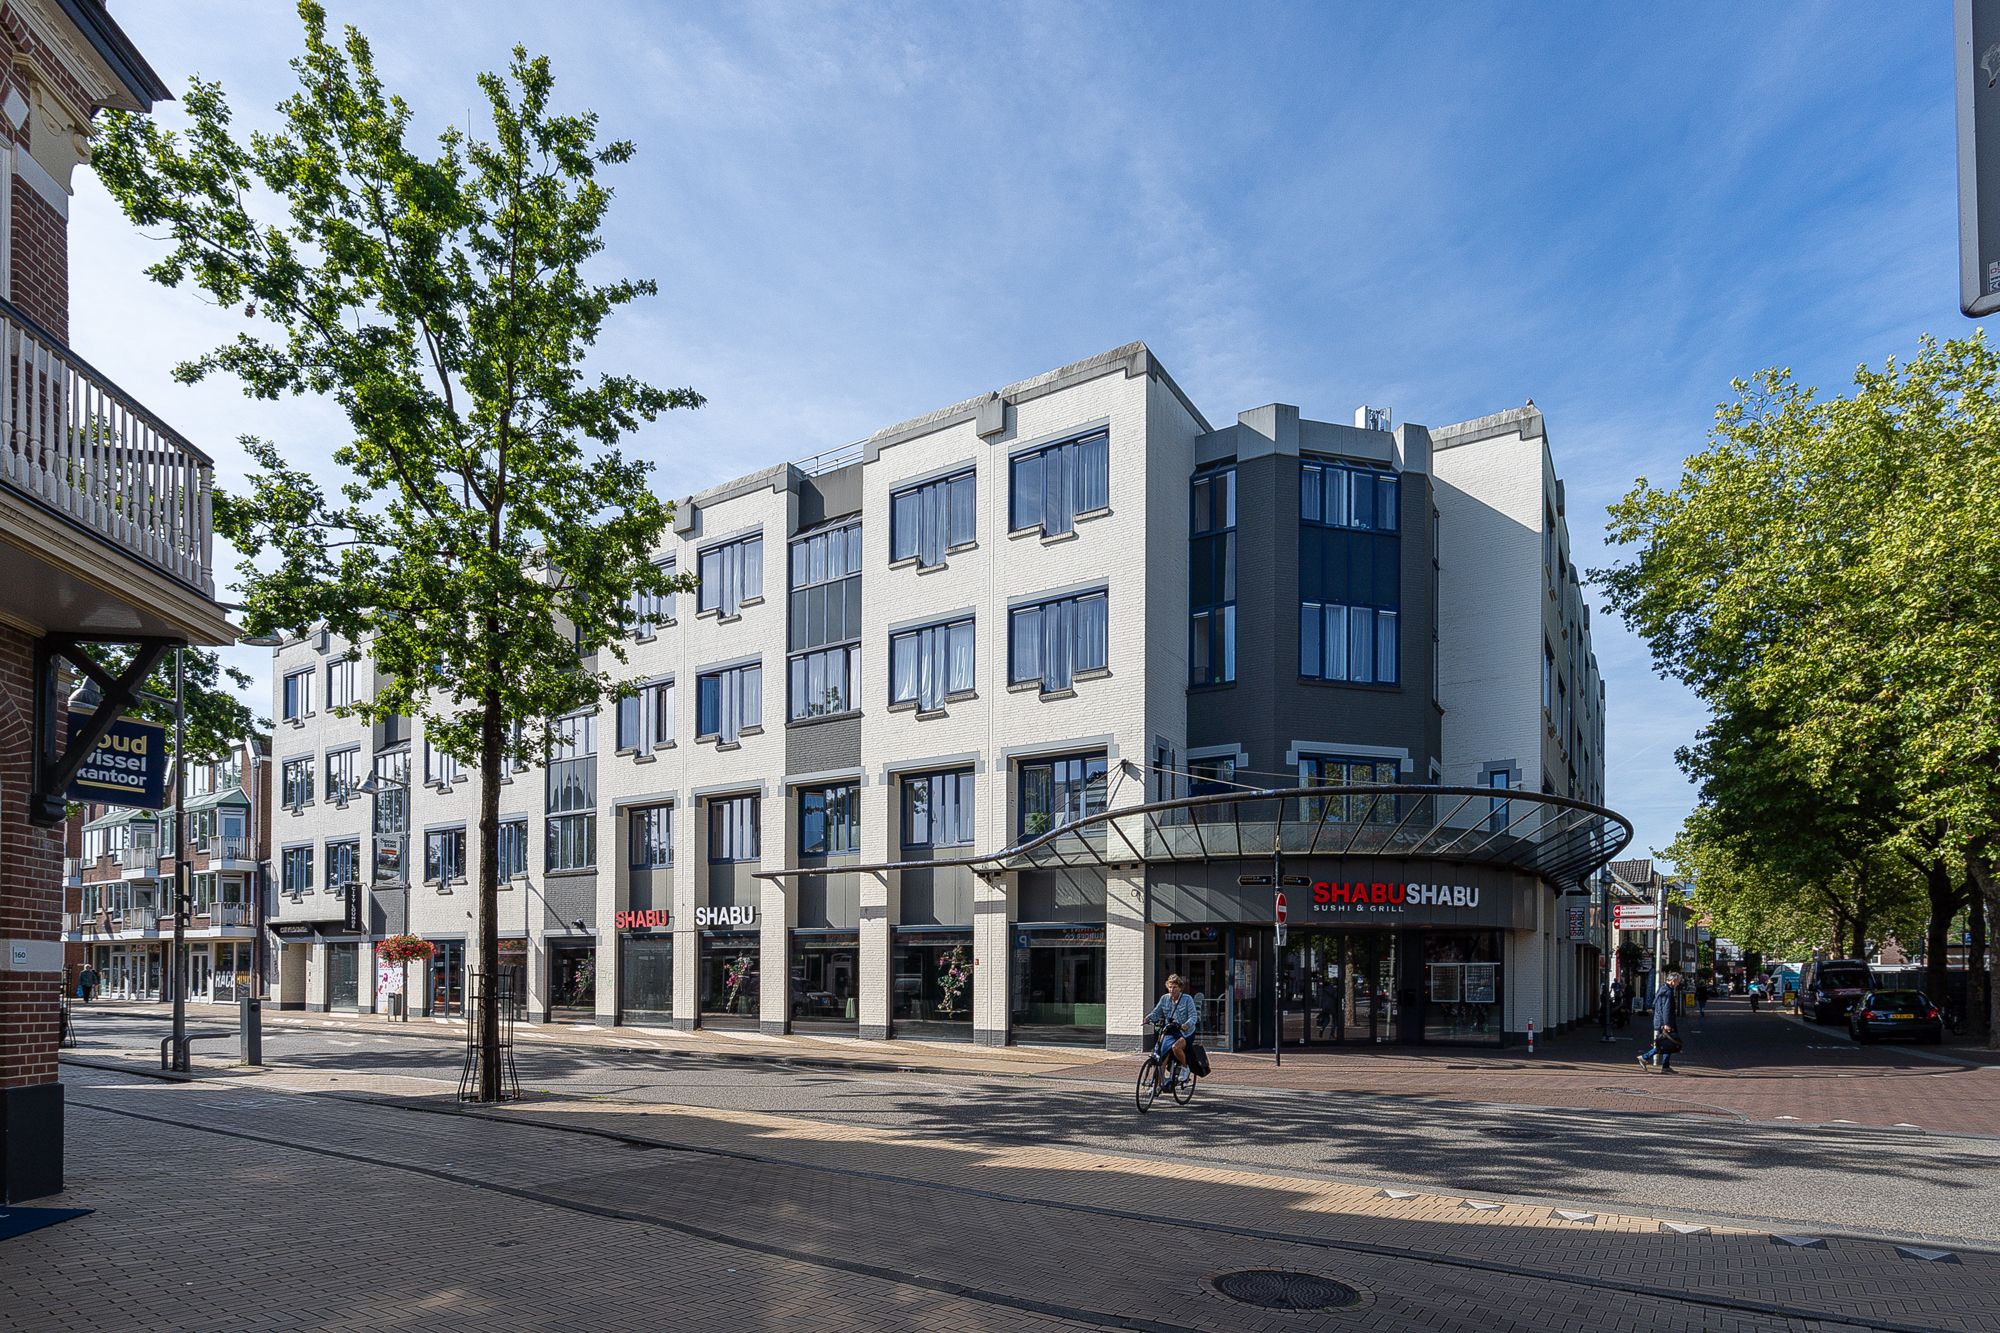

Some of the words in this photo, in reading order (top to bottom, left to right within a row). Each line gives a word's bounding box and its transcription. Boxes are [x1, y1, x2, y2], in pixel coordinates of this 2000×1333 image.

[1313, 904, 1350, 912] SUSHI
[1356, 904, 1364, 912] &
[615, 909, 668, 928] SHABU
[695, 905, 755, 925] SHABU
[15, 951, 26, 959] 160
